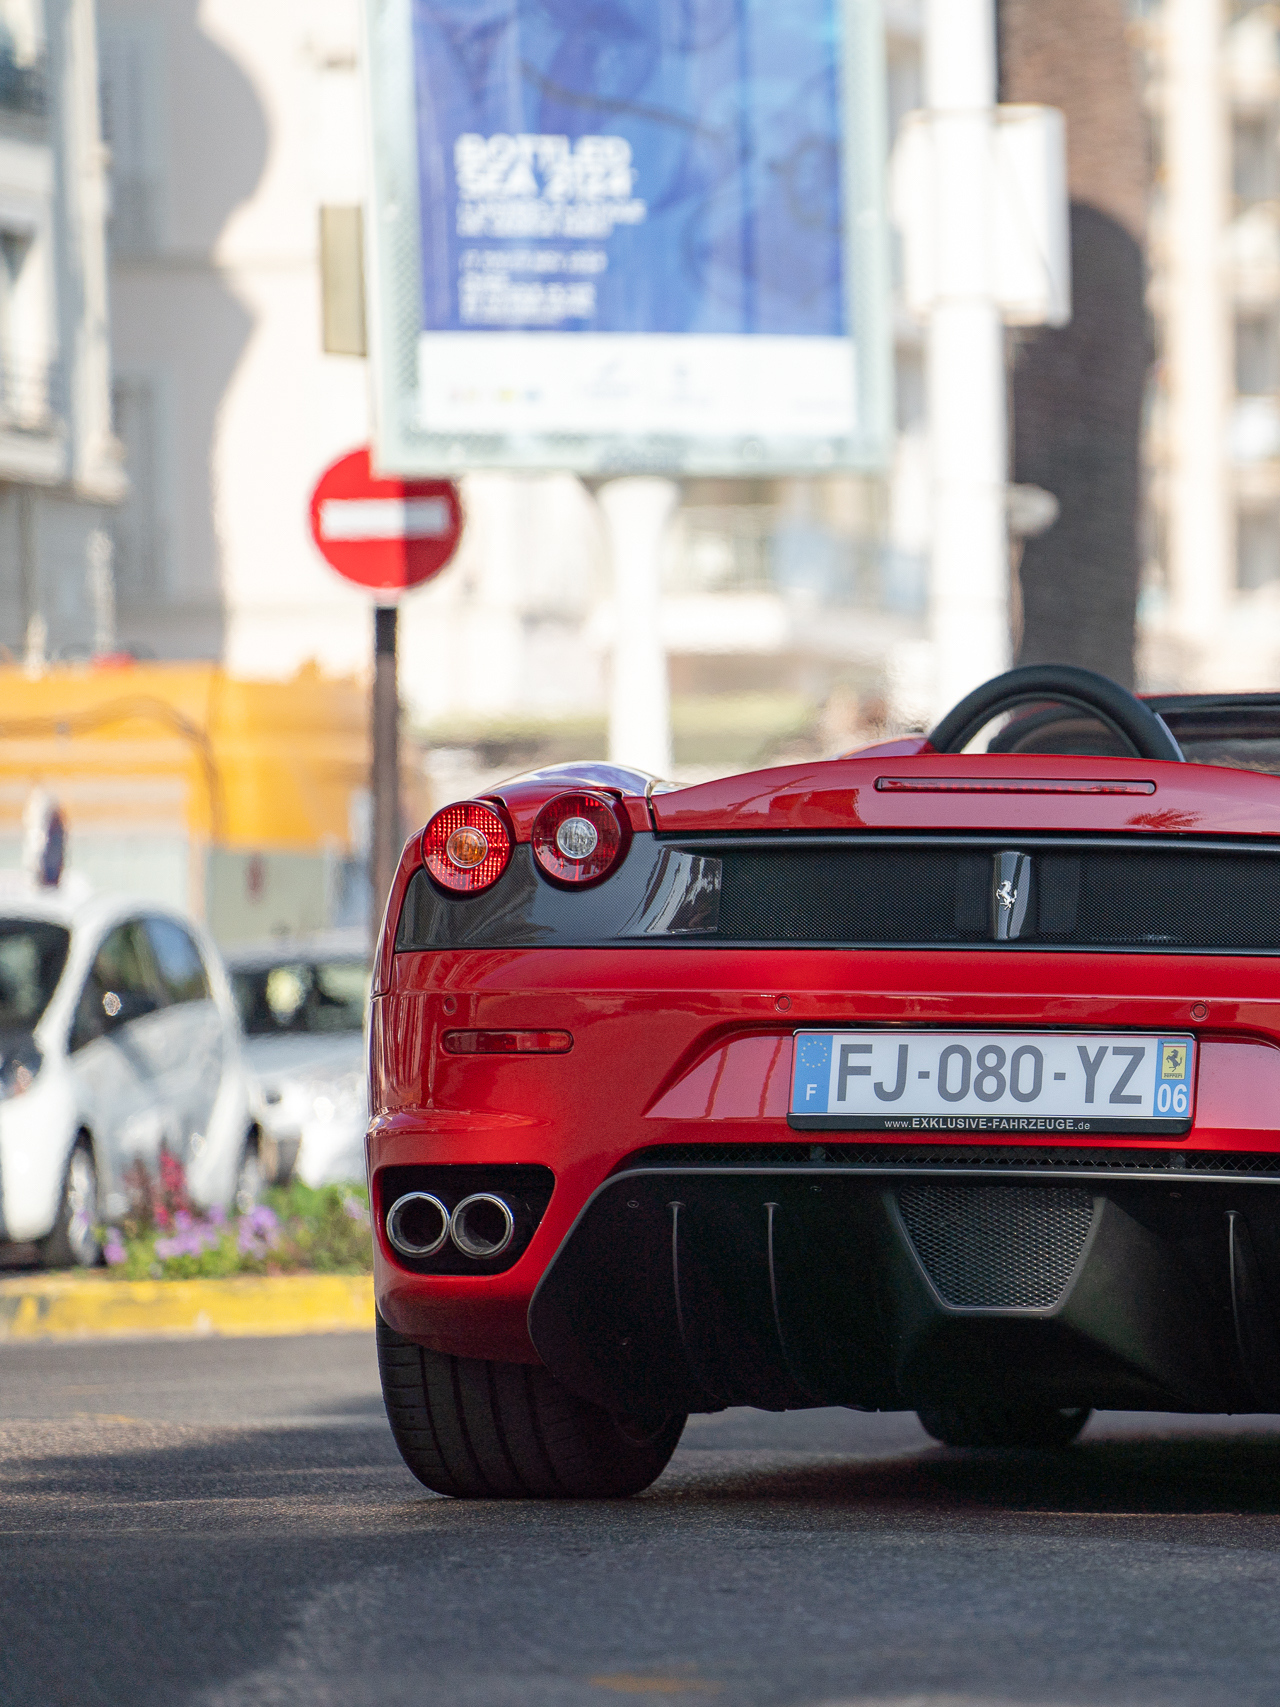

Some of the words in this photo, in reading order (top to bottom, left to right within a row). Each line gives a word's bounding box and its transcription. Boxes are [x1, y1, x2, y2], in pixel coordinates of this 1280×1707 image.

[836, 1043, 1146, 1105] FJ-080-YZ
[806, 1083, 817, 1101] F
[1157, 1083, 1187, 1113] 06
[884, 1117, 1091, 1130] www.EXKLUSIVE-FAHRZEUGE.de
